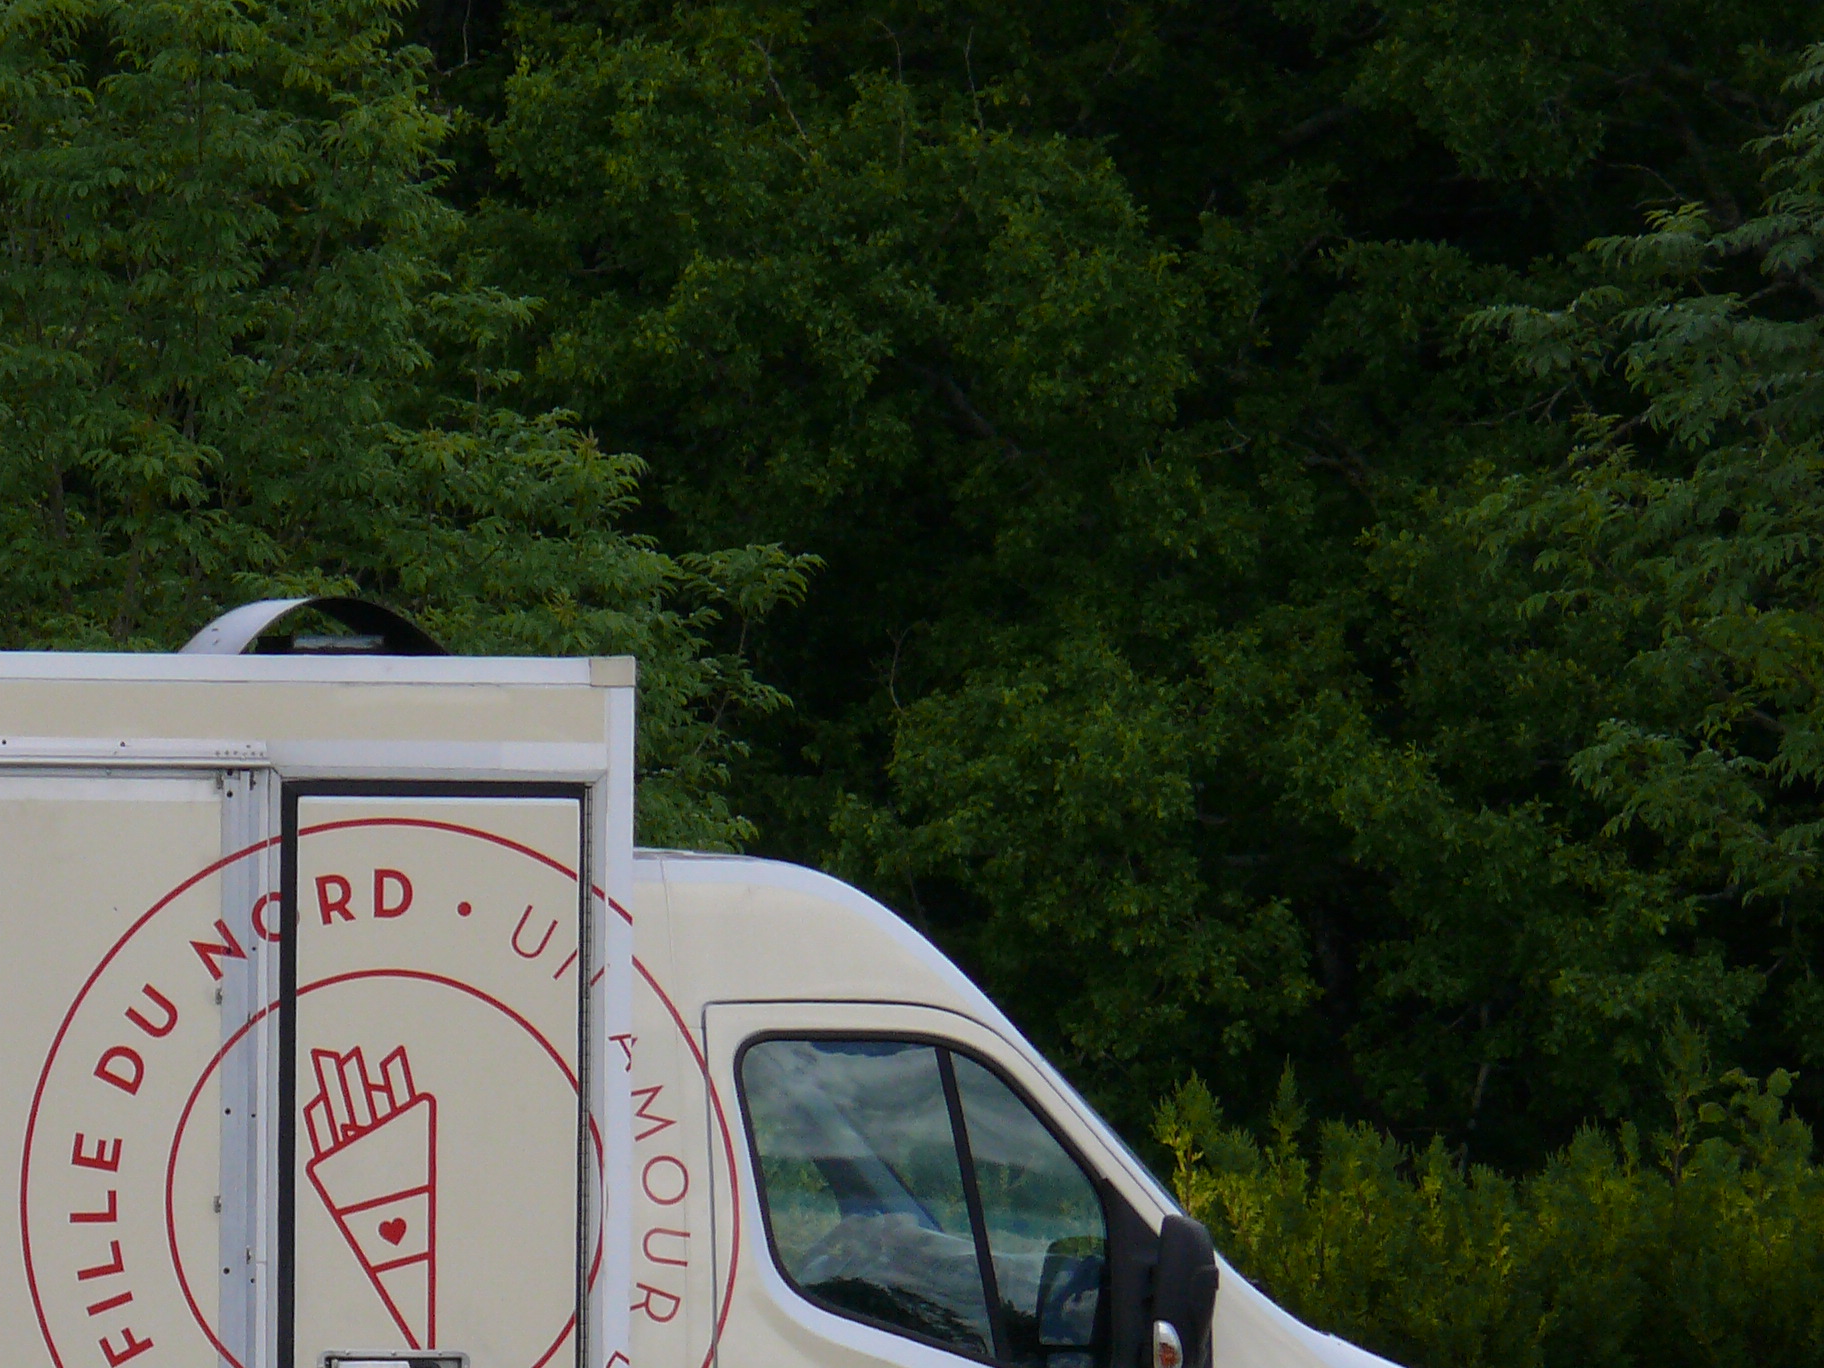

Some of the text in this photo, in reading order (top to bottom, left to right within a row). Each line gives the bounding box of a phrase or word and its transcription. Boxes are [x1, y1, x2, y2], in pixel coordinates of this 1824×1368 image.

[189, 869, 413, 981] NORD
[94, 983, 178, 1095] DU
[70, 1132, 154, 1368] FILLE
